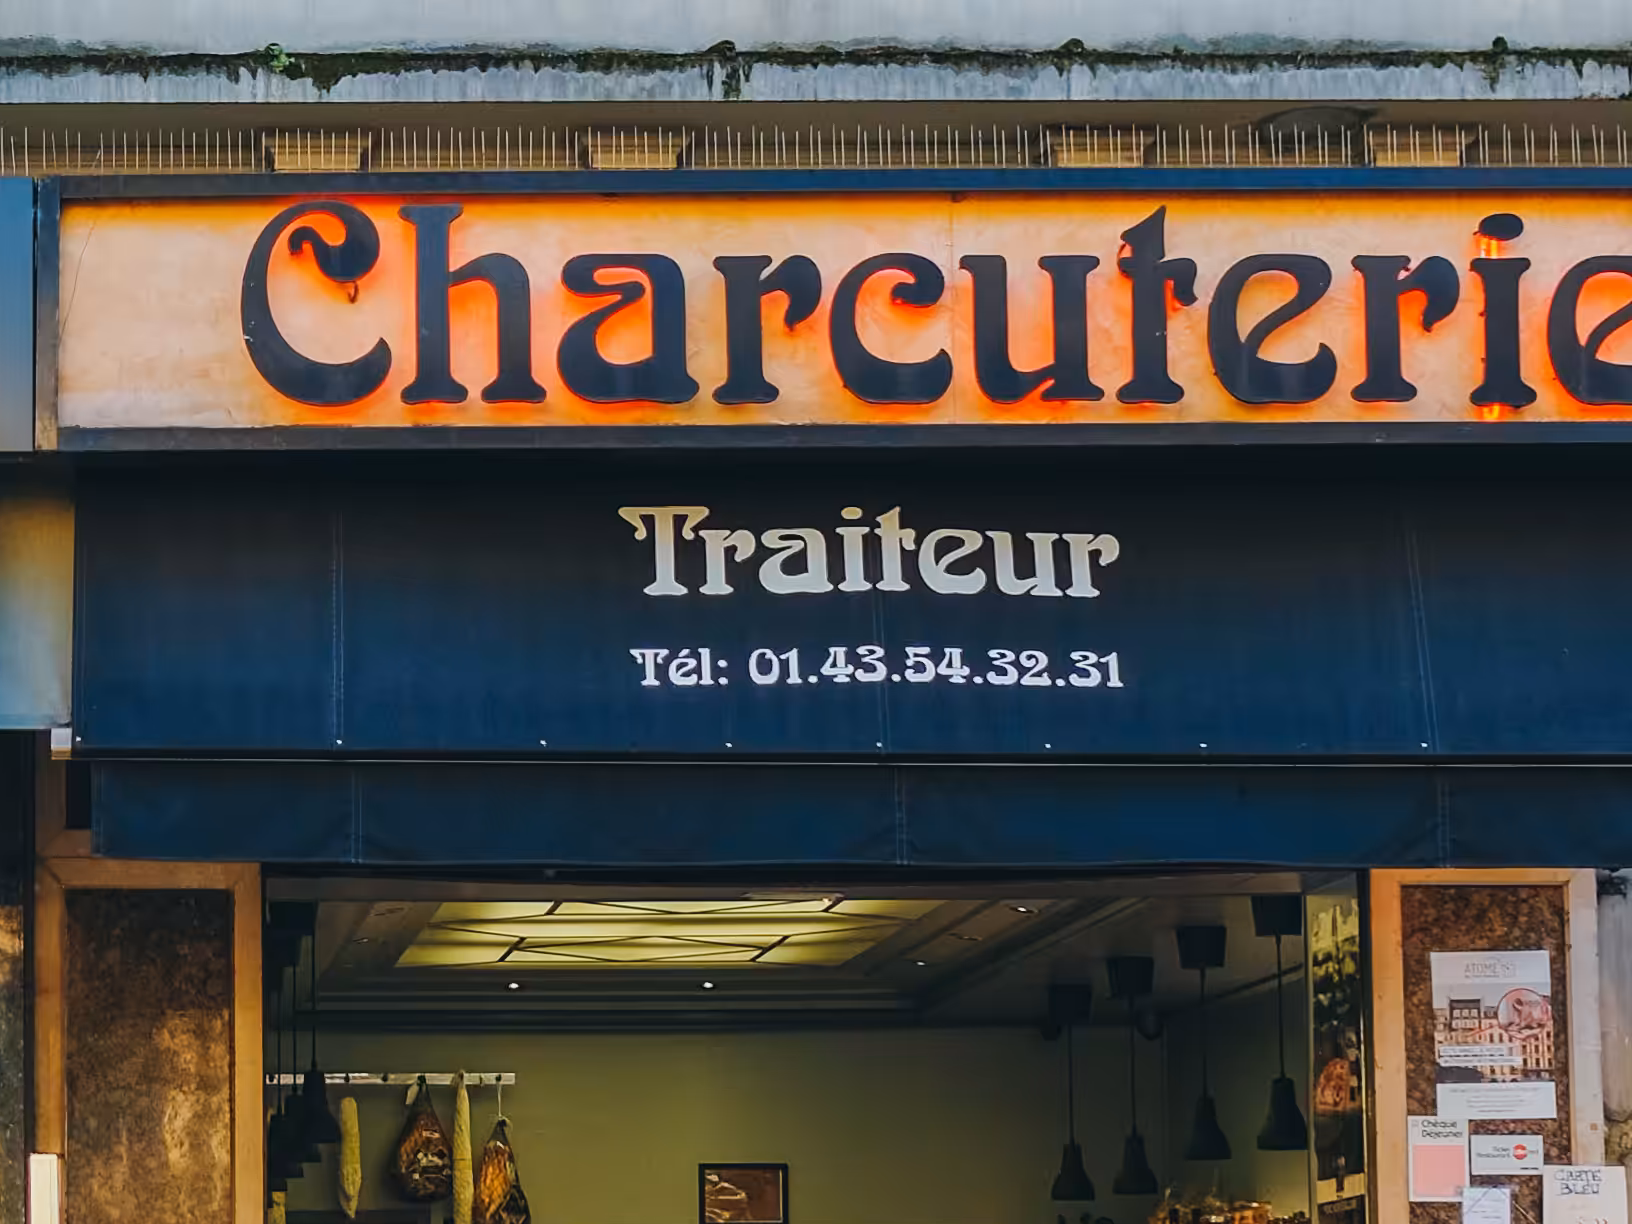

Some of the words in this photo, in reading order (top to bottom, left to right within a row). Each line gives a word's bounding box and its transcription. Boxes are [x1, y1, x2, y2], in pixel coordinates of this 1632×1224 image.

[241, 200, 1632, 407] Charcuterie
[618, 506, 1120, 598] Traiteur
[629, 648, 728, 686] Tél:
[748, 645, 1124, 688] 01.43.54.32.31
[1554, 1169, 1602, 1183] CARTE
